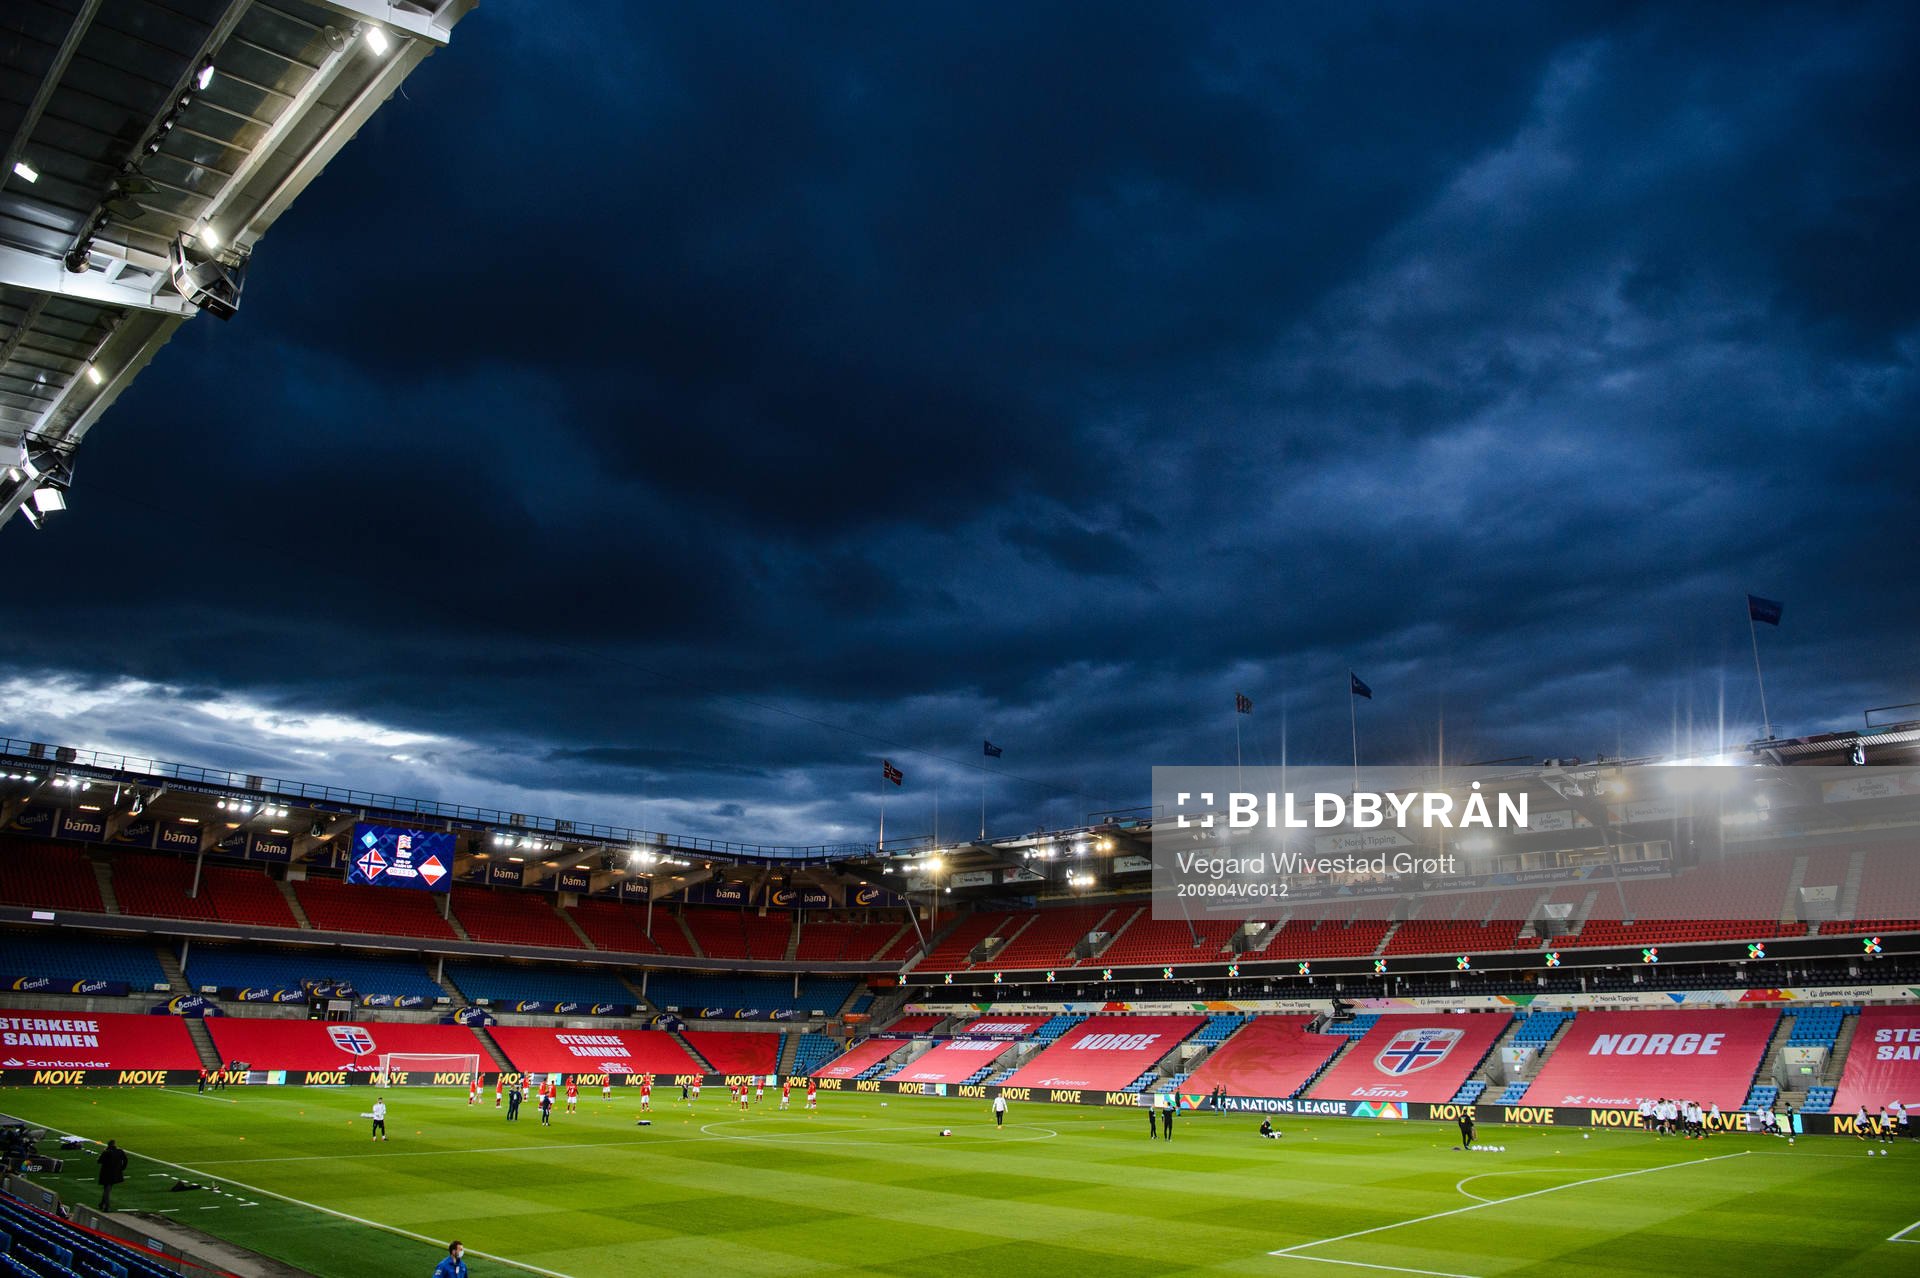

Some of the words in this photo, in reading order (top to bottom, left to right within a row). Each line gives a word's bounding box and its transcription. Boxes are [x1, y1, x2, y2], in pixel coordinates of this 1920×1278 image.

[168, 783, 198, 794] OPPLEV
[64, 818, 101, 834] bama
[164, 830, 198, 844] bama
[1344, 838, 1366, 848] Norsk
[1368, 835, 1396, 846] Tipping
[256, 840, 288, 856] bama
[494, 868, 520, 880] bama
[562, 875, 586, 887] bama
[626, 882, 648, 894] bama
[716, 888, 741, 900] bama
[804, 894, 827, 903] bama
[24, 978, 50, 990] Bendit
[82, 980, 108, 993] Bendit
[178, 996, 204, 1009] Bendit
[0, 1018, 100, 1032] STERKERE
[3, 1032, 99, 1048] SAMMEN
[556, 1034, 624, 1046] STERKERE
[1070, 1034, 1162, 1050] NORGE
[1588, 1034, 1725, 1056] NORGE
[568, 1046, 632, 1058] SAMMEN
[26, 1060, 111, 1068] Santander
[33, 1071, 86, 1084] MOVE
[118, 1071, 168, 1084] MOVE
[305, 1072, 347, 1084] MOVE
[434, 1072, 471, 1084] MOVE
[725, 1076, 752, 1086] MOVE
[820, 1078, 842, 1090] MOVE
[856, 1080, 880, 1092] MOVE
[898, 1082, 924, 1094] MOVE
[958, 1086, 986, 1098] MOVE
[1002, 1088, 1030, 1100] MOVE
[1051, 1090, 1081, 1103] MOVE
[1350, 1086, 1409, 1098] bama
[1106, 1092, 1138, 1106] MOVE
[1587, 1096, 1632, 1105] Norsk
[1241, 1098, 1294, 1112] NATIONS
[1297, 1100, 1347, 1114] LEAGUE
[1505, 1107, 1554, 1124] MOVE
[1592, 1110, 1644, 1128] MOVE
[27, 1164, 42, 1172] NEP
